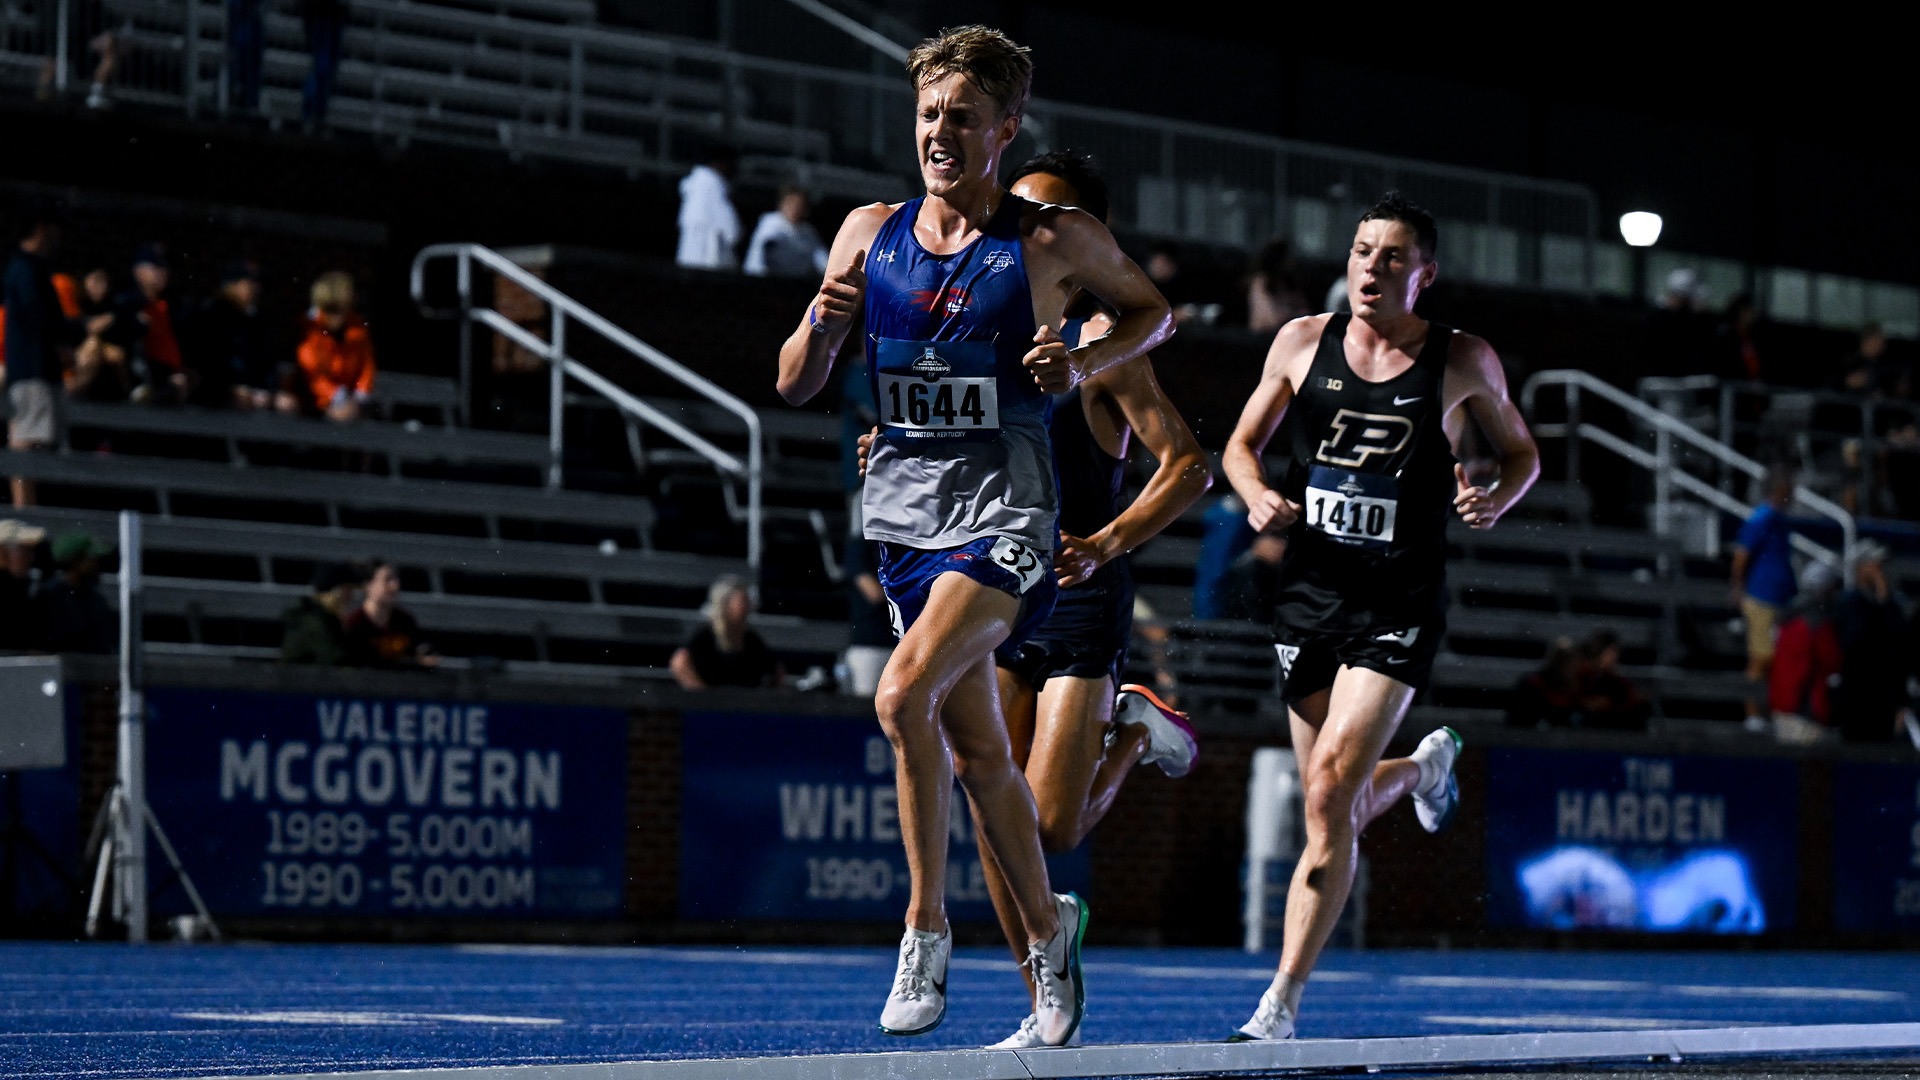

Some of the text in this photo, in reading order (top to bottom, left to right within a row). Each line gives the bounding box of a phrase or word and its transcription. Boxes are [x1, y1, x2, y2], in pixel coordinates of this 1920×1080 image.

[889, 382, 985, 426] 1644
[936, 430, 967, 438] KENTUCKY
[1315, 408, 1415, 468] P
[1315, 497, 1385, 536] 1410
[1000, 540, 1037, 583] 32
[316, 700, 489, 747] VALERIE
[219, 738, 563, 811] MCGOVERN
[1623, 757, 1674, 791] TIM
[1556, 788, 1728, 844] HARDEN
